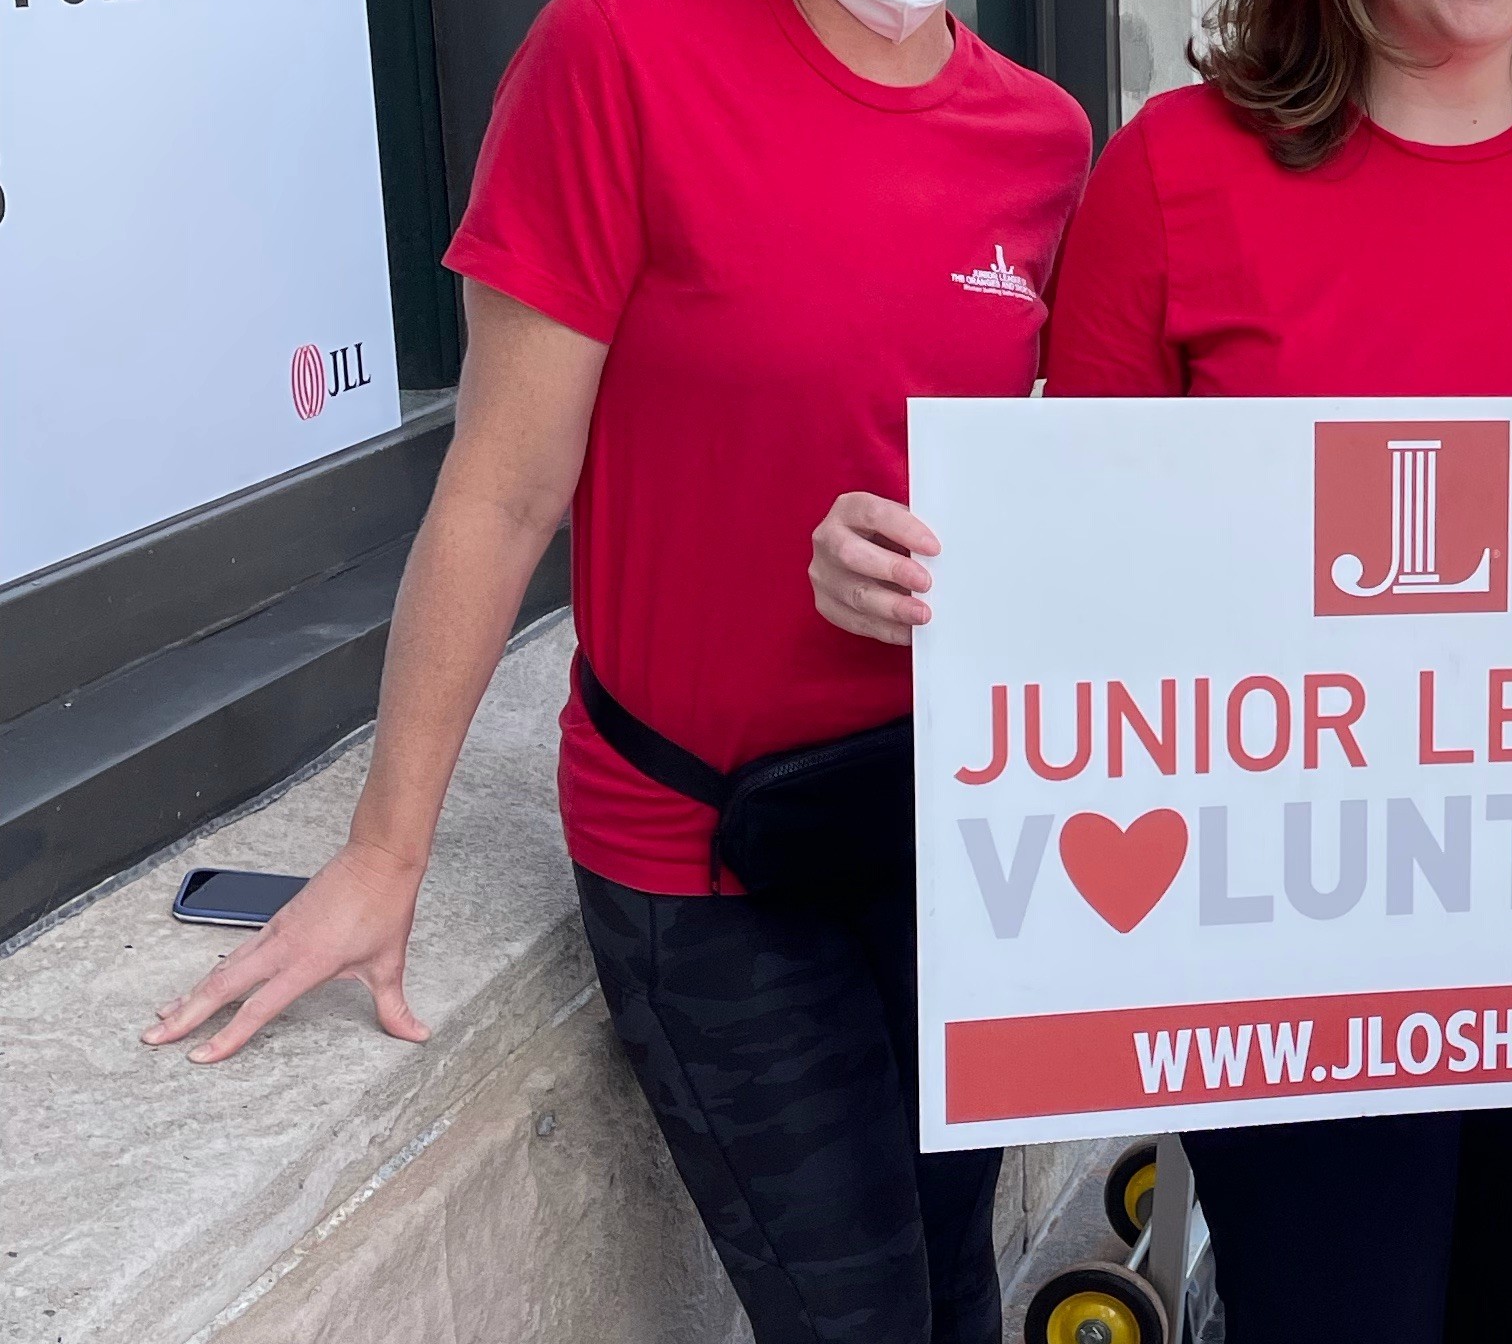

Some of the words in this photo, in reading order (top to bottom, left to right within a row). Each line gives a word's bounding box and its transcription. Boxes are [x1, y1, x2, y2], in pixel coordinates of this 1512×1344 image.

[329, 342, 371, 397] JLL
[1331, 440, 1491, 597] JL
[953, 673, 1367, 786] JUNIOR
